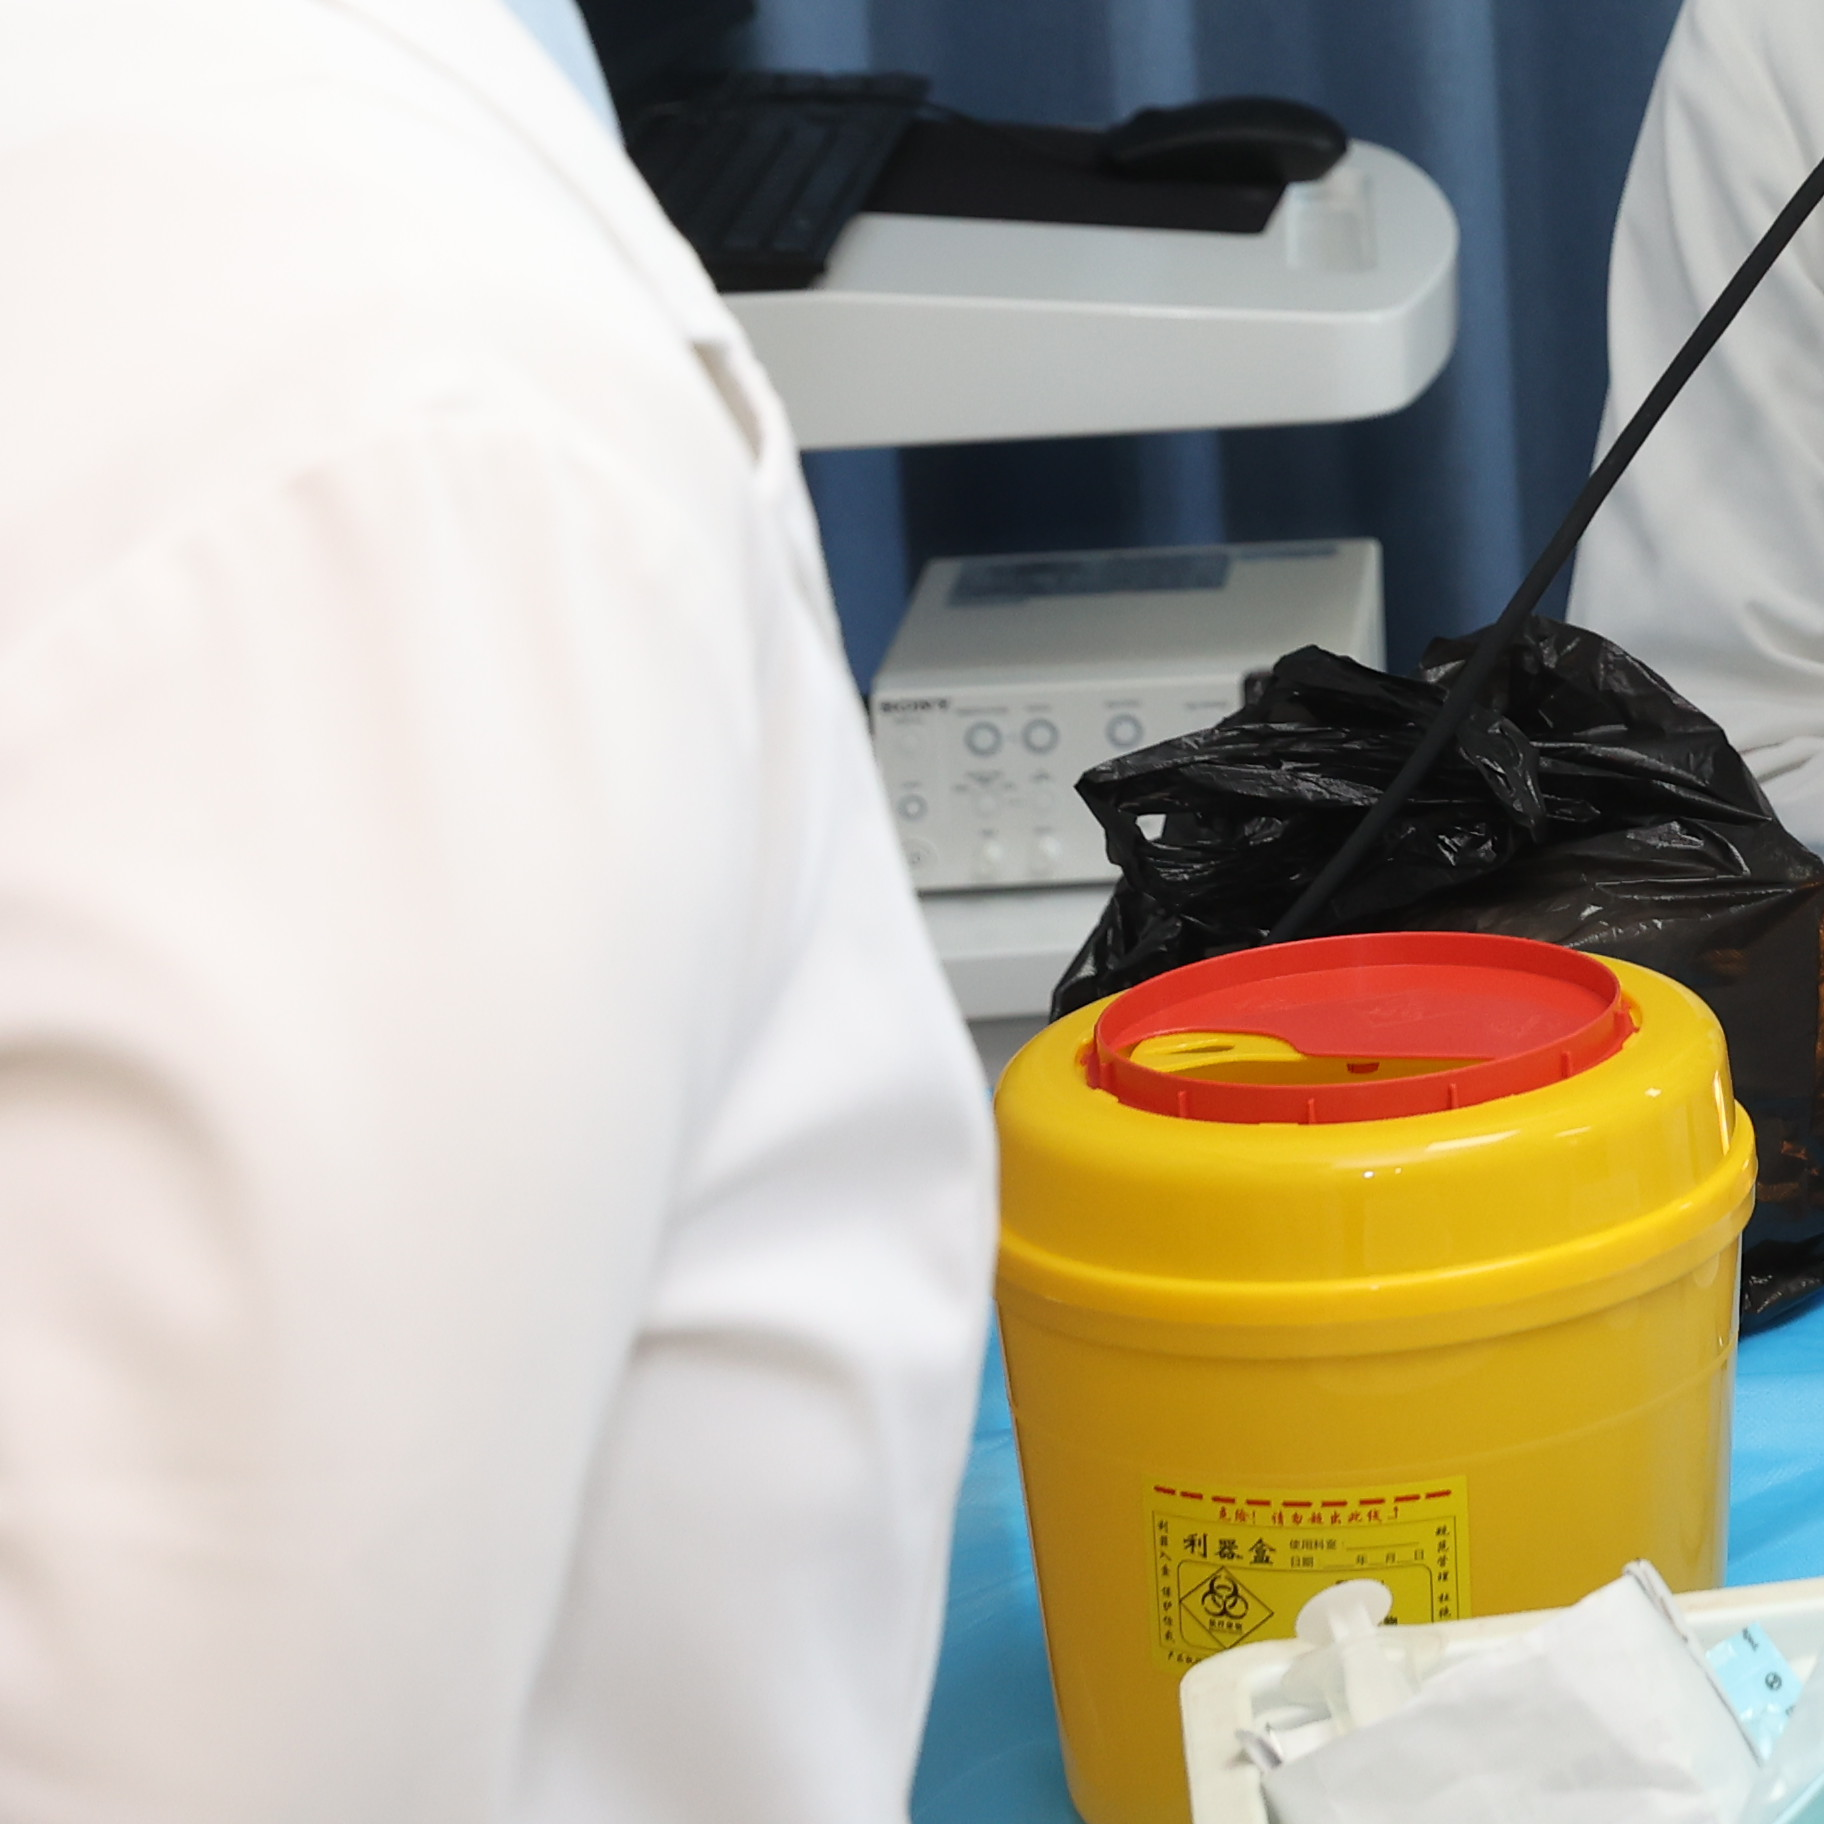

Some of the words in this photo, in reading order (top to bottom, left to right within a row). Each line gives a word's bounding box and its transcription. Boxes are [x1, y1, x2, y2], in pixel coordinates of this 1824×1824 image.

[1183, 1532, 1276, 1566] 利器盒
[1291, 1555, 1314, 1568] 日期
[1356, 1554, 1368, 1566] 年
[1385, 1551, 1396, 1564] 月
[1413, 1548, 1425, 1561] 日
